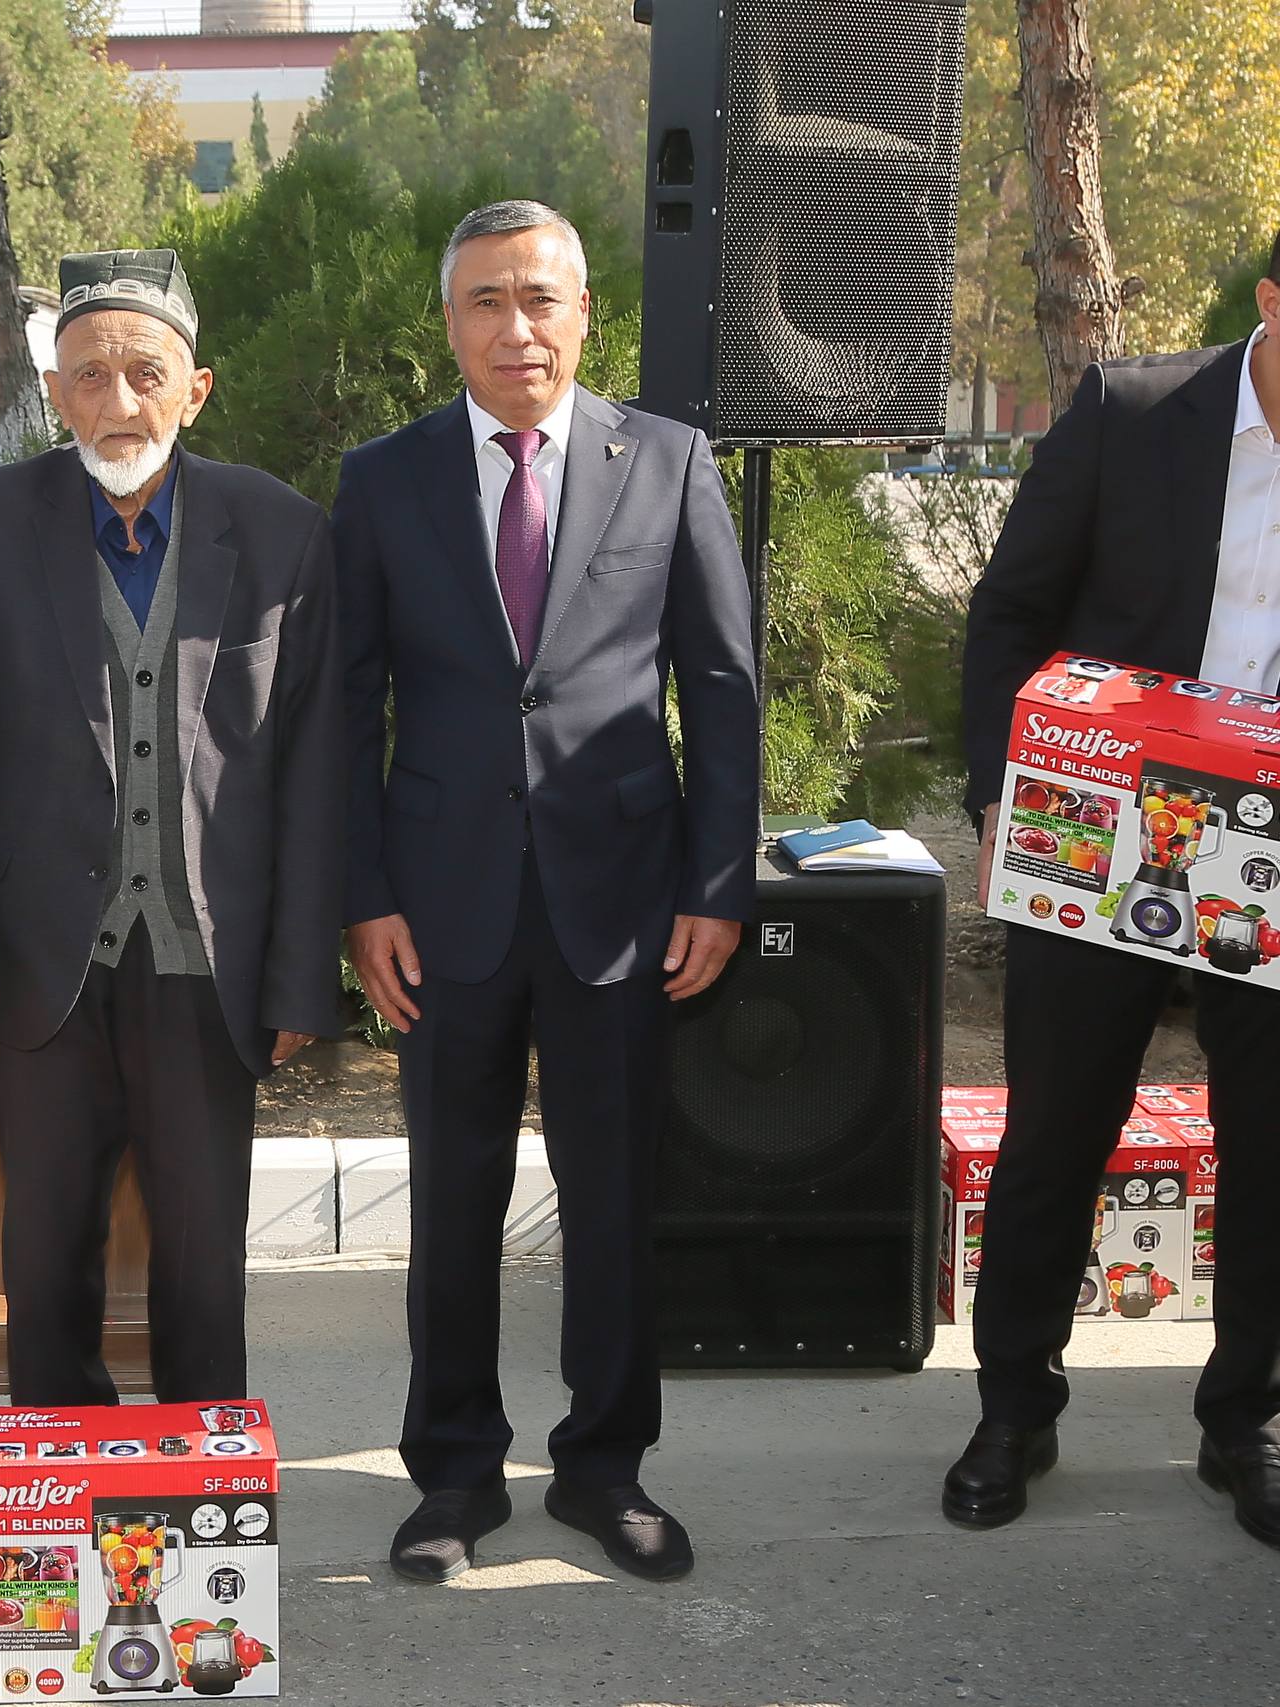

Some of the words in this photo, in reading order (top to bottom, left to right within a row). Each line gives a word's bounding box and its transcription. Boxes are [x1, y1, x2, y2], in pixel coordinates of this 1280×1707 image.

[1022, 713, 1137, 760] Sonifer
[1018, 749, 1027, 761] 2
[1031, 752, 1045, 766] IN
[1050, 757, 1056, 768] 1
[1061, 759, 1132, 787] BLENDER
[1012, 807, 1028, 817] EASY
[1029, 811, 1037, 819] TO
[1037, 813, 1054, 824] DEAL
[1055, 817, 1073, 827] WITH
[1072, 821, 1086, 830] ANY
[1086, 825, 1105, 836] KINDS
[1083, 832, 1102, 842] HARD
[1265, 851, 1280, 865] MOTO
[1061, 911, 1083, 922] 400W
[1134, 1159, 1179, 1170] SF-8006
[965, 1190, 972, 1199] 2
[974, 1190, 985, 1199] IN
[1195, 1184, 1201, 1193] 2
[1204, 1184, 1215, 1193] IN
[204, 1477, 268, 1492] SF-8006
[0, 1520, 6, 1531] 1
[12, 1518, 86, 1531] BLENDER
[38, 1678, 61, 1686] 400W
